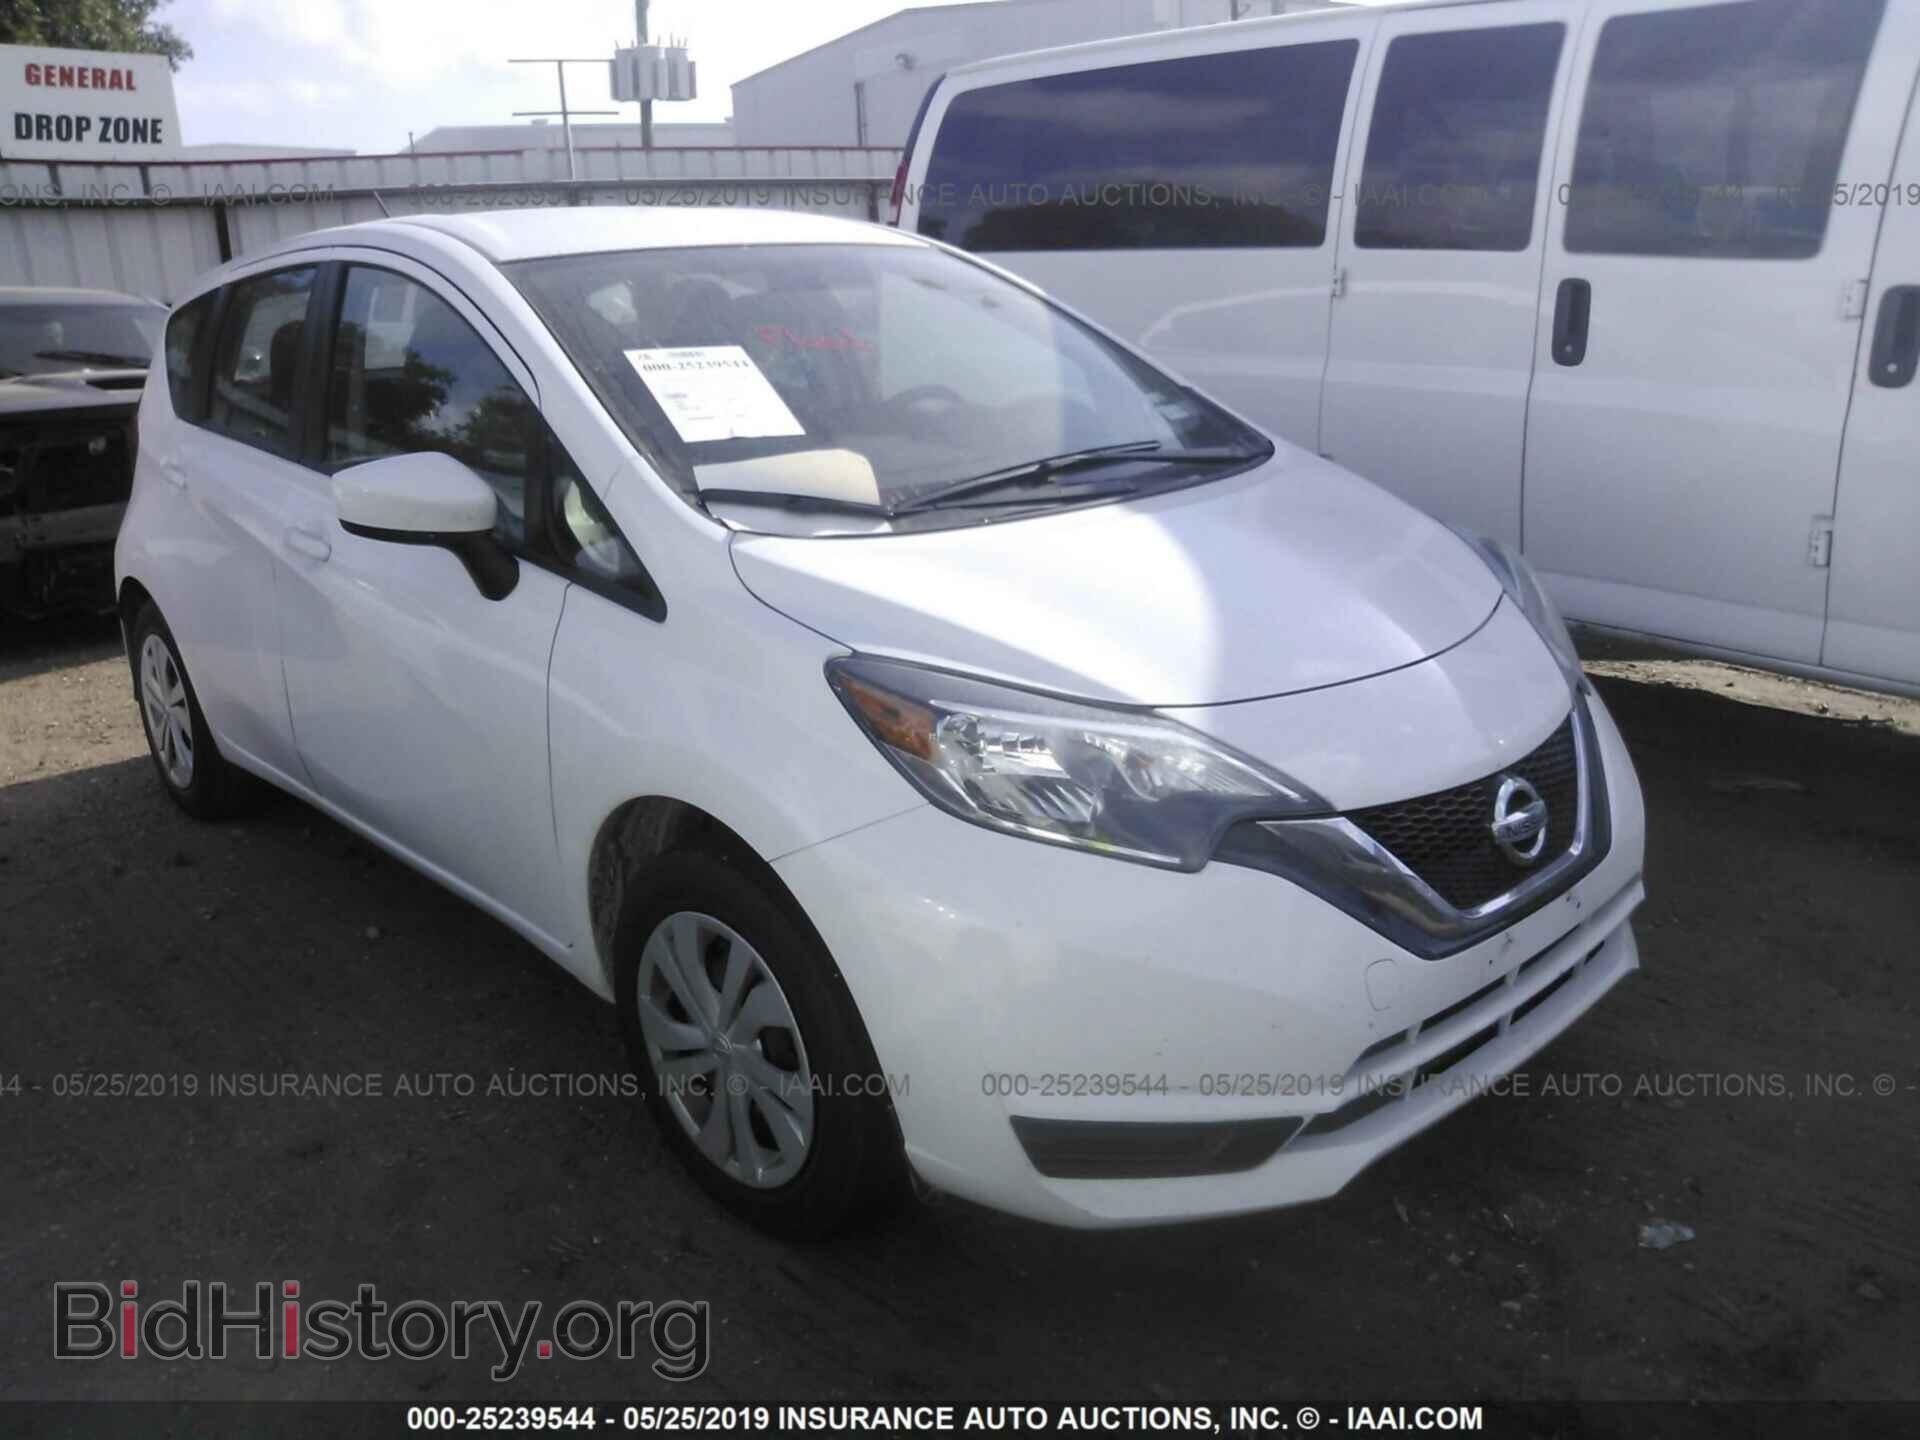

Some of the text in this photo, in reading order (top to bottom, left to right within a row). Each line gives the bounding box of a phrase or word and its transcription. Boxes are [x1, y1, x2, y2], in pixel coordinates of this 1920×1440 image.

[25, 63, 136, 91] GENERAL
[14, 112, 163, 144] DROP ZONE
